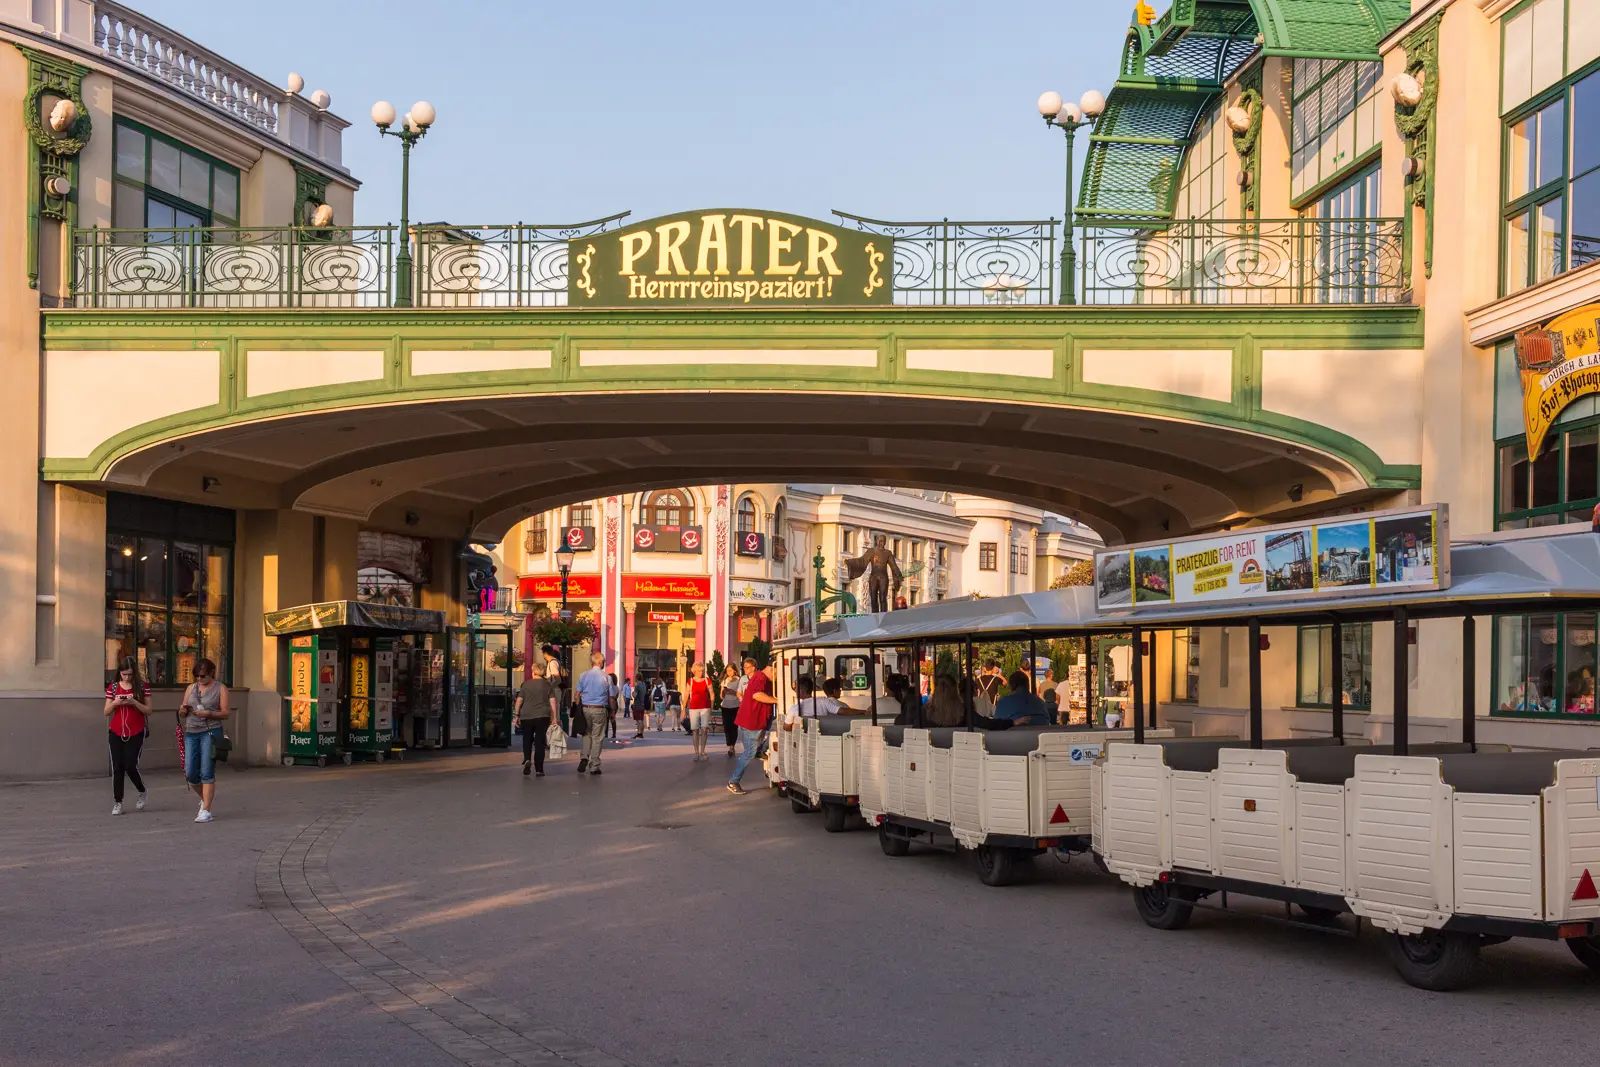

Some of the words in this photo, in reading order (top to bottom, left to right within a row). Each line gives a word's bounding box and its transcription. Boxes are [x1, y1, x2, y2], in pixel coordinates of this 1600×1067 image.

[618, 213, 843, 276] PRATER
[628, 275, 834, 304] Herrrreinspaziert!
[1566, 335, 1572, 346] K
[1588, 327, 1595, 339] K
[1547, 363, 1576, 385] DURCH
[1578, 357, 1585, 368] &
[1176, 549, 1218, 574] PRATERZUG
[1219, 545, 1234, 562] FOR
[1236, 539, 1256, 559] RENT
[535, 580, 556, 593] Madame
[635, 581, 667, 592] Madame
[665, 580, 699, 597] Tussauds
[729, 590, 746, 598] Walk
[652, 613, 680, 621] Eingang
[296, 660, 307, 696] photo
[355, 661, 365, 696] photo
[290, 734, 312, 746] Prater
[318, 734, 337, 746] Prater
[349, 733, 370, 744] Prater
[375, 732, 392, 743] Prater
[1085, 751, 1092, 759] 10
